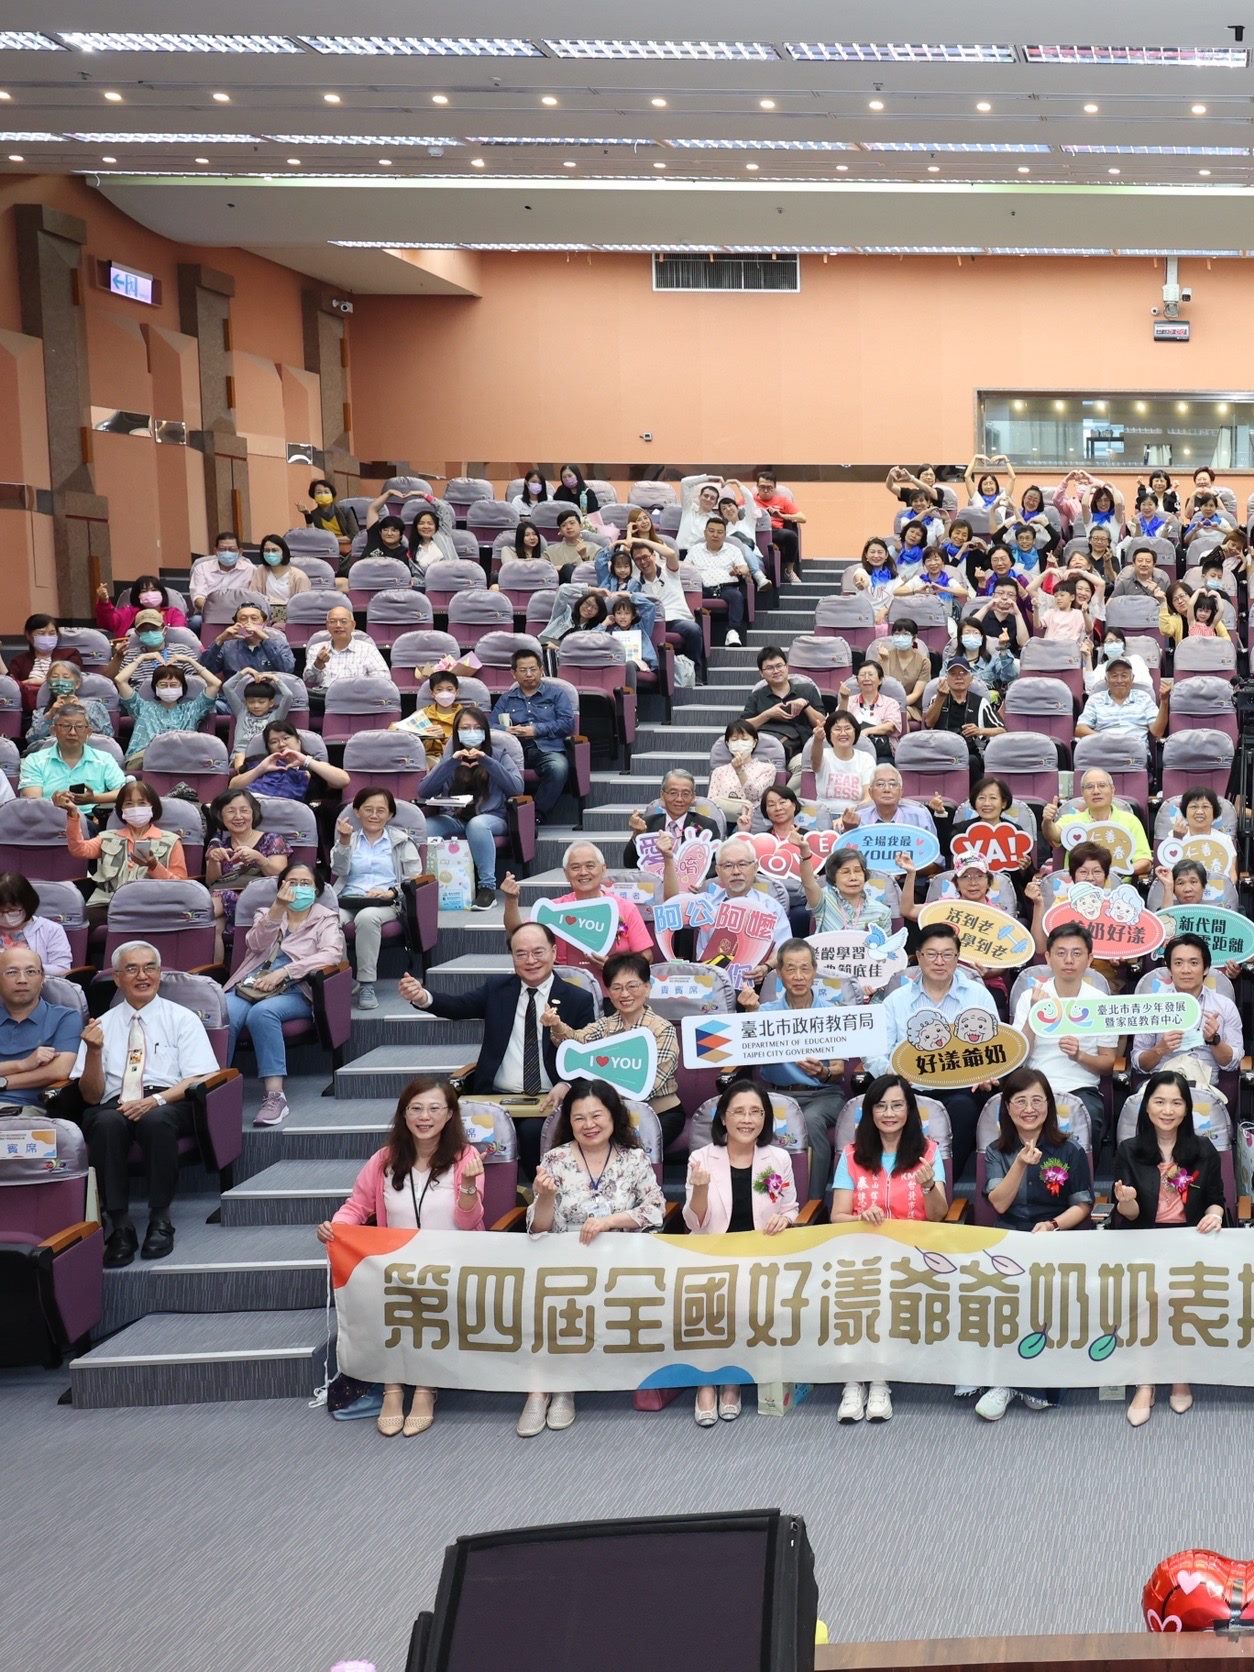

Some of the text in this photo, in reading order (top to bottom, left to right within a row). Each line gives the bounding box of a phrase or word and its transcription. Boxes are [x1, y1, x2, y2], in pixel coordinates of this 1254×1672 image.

[829, 773, 860, 788] FEAR
[826, 786, 860, 801] LESS
[862, 835, 912, 847] 全場我最
[963, 836, 1018, 864] YA!
[559, 913, 605, 933] I YOU
[944, 907, 994, 936] 活到老
[1179, 915, 1227, 934] 新代間
[1077, 920, 1146, 944] 奶好漾
[959, 934, 1009, 961] 學到老
[660, 984, 698, 995] 貴賓席
[1097, 1001, 1187, 1016] 臺北市青少年發展
[741, 1012, 875, 1039] 臺北市政府教育局
[1105, 1014, 1183, 1029] 暨家庭教育中心
[742, 1040, 790, 1050] DEPARTMENT
[804, 1035, 847, 1046] EDUCATION
[743, 1046, 835, 1059] TAIPEI CITY GOVERNMENT
[916, 1044, 1007, 1076] 好漾爺奶
[589, 1055, 642, 1070] I YOU
[7, 1142, 37, 1153] 賓席
